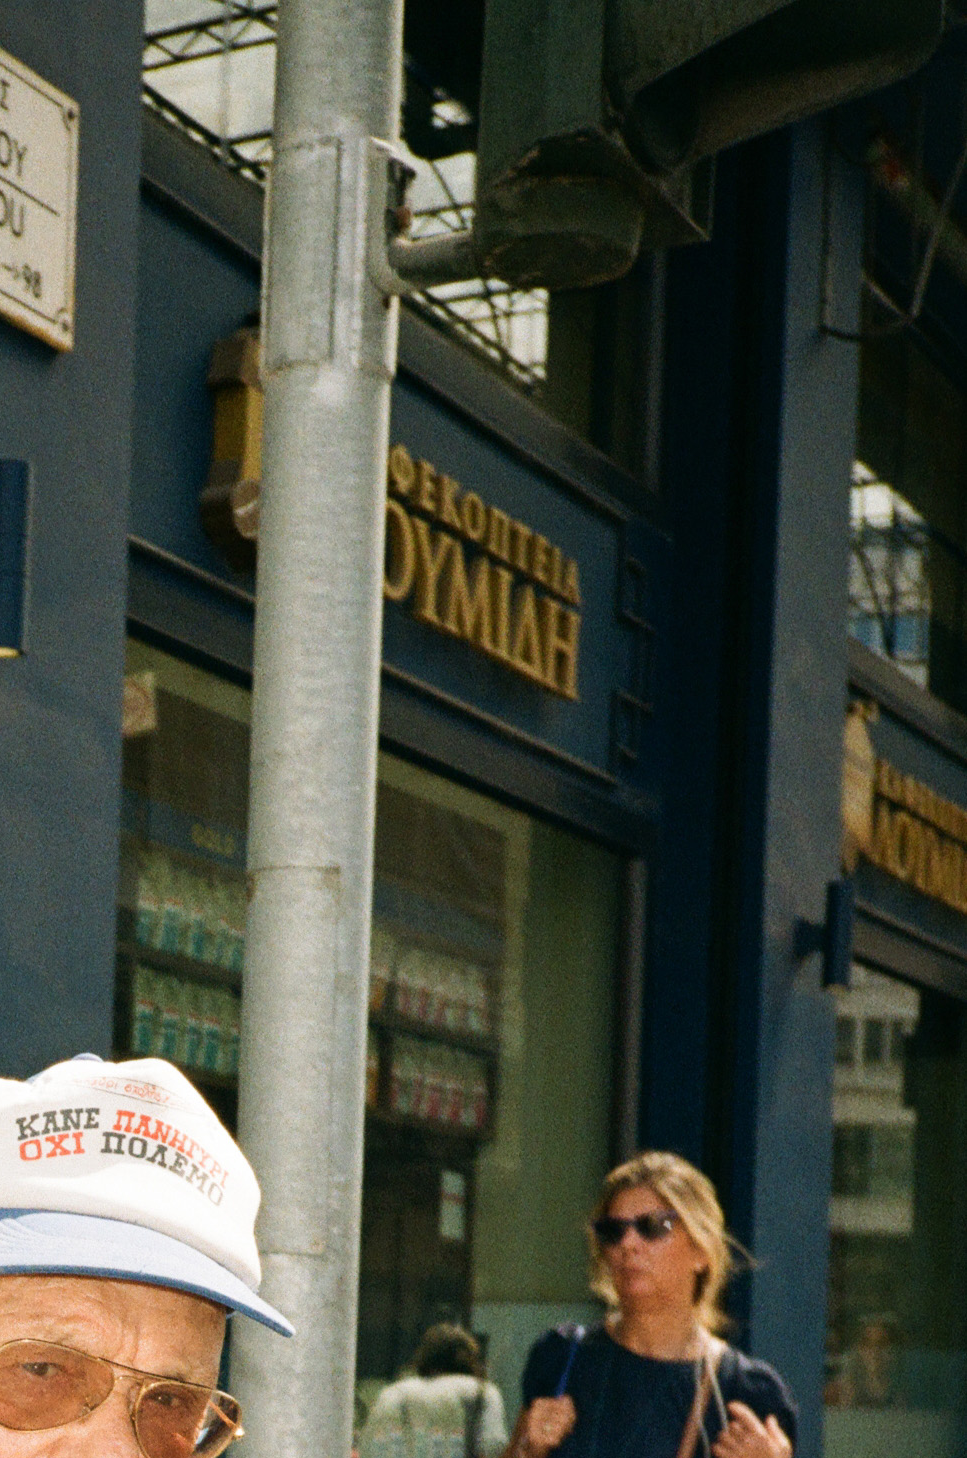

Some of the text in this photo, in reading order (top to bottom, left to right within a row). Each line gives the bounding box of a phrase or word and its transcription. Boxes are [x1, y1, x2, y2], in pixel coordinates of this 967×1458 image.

[388, 443, 581, 606] ΦΕΚΟΠΤΕΙΑ
[383, 500, 582, 701] ΟΥΜΙΔΗ
[15, 1107, 229, 1189] ΚΑΝΕ ΠΑΝΗΓΥΡΙ
[19, 1131, 224, 1206] ΟΧΙ ΠΟΛΕΜΟ
